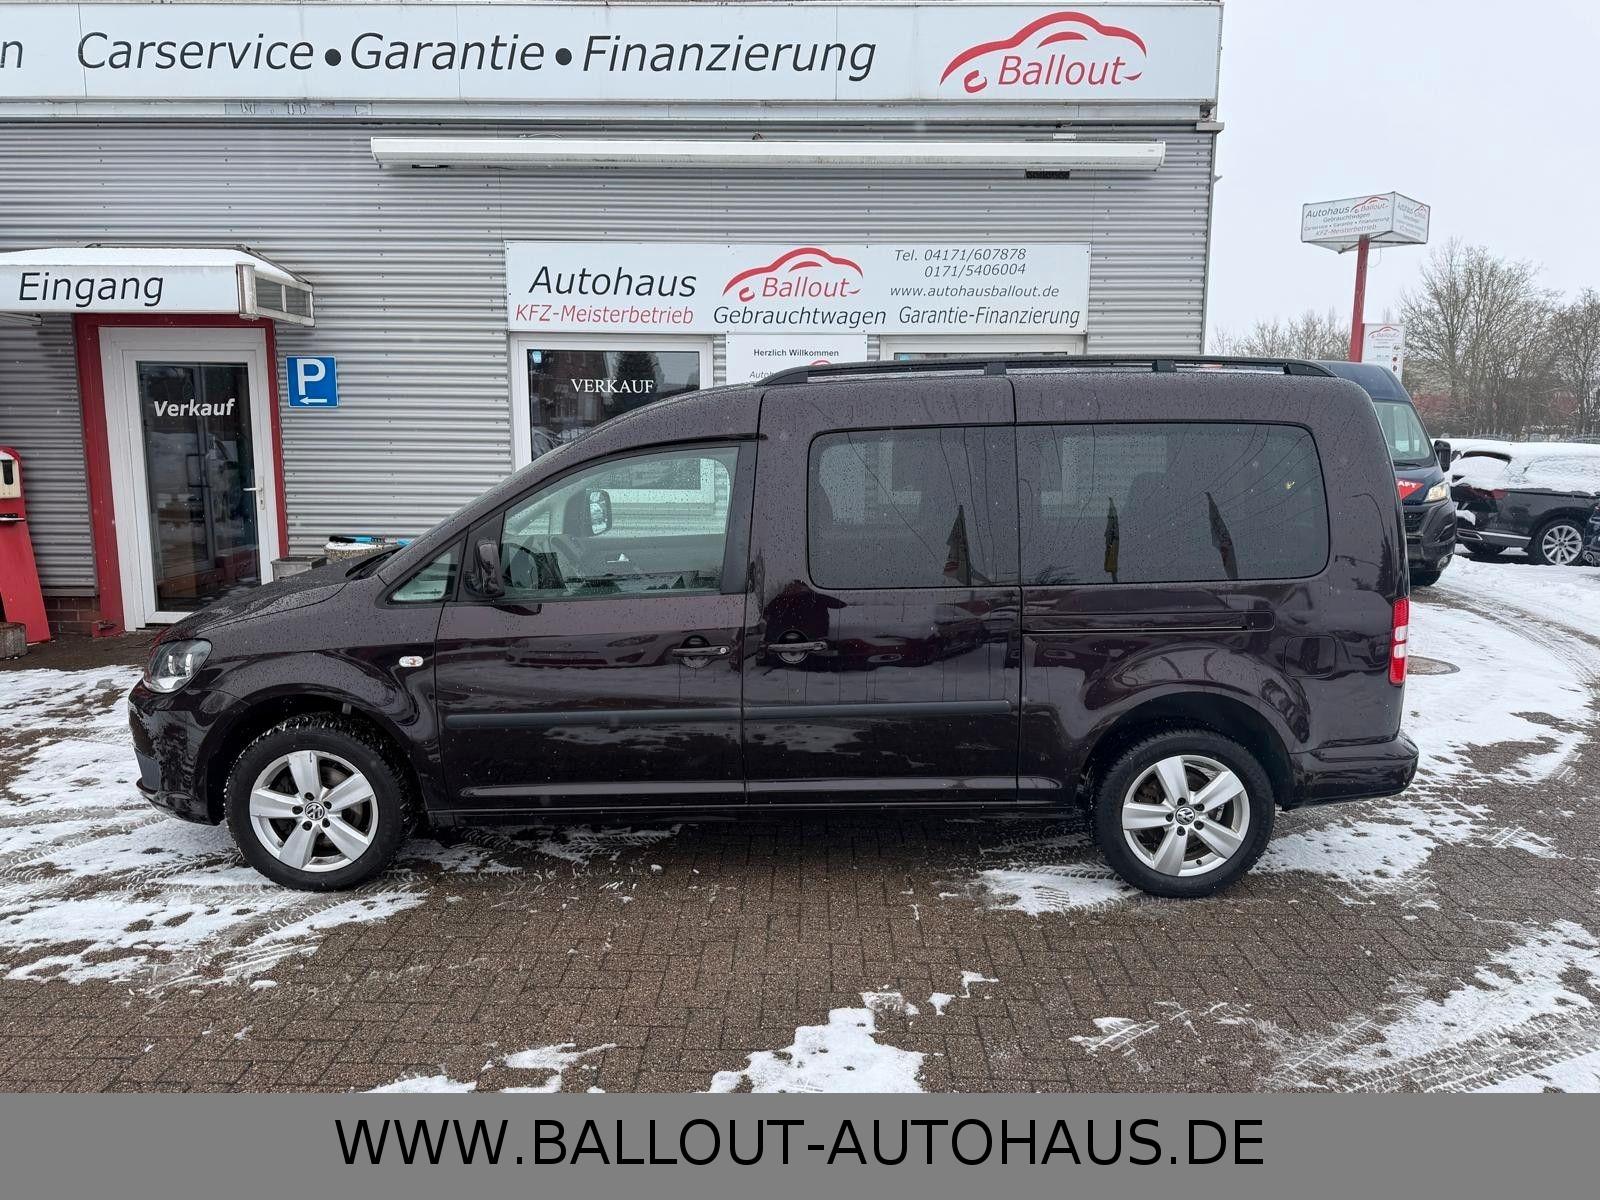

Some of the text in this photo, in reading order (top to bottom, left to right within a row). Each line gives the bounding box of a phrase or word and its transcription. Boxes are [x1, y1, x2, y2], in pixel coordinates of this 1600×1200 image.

[77, 32, 876, 82] Carservice Garantie Finanzierung
[998, 54, 1126, 86] Ballout
[1305, 206, 1350, 218] Autohaus
[894, 248, 1027, 261] Tel. 04171/607878
[924, 263, 1026, 278] 0171/5406004
[18, 271, 164, 308] Eingang
[528, 266, 697, 297] Autohaus
[762, 276, 850, 298] Ballout
[890, 285, 1060, 298] www.autohausballout.de
[515, 304, 694, 325] KFZ-Meisterbetrieb
[713, 306, 887, 329] Gebrauchtwagen
[899, 305, 1081, 328] Garantie-Finanzierung
[753, 348, 840, 357] Herzlich Willkommen
[296, 358, 326, 395] P
[571, 378, 654, 394] VERKAUF
[153, 397, 236, 418] Verkauf
